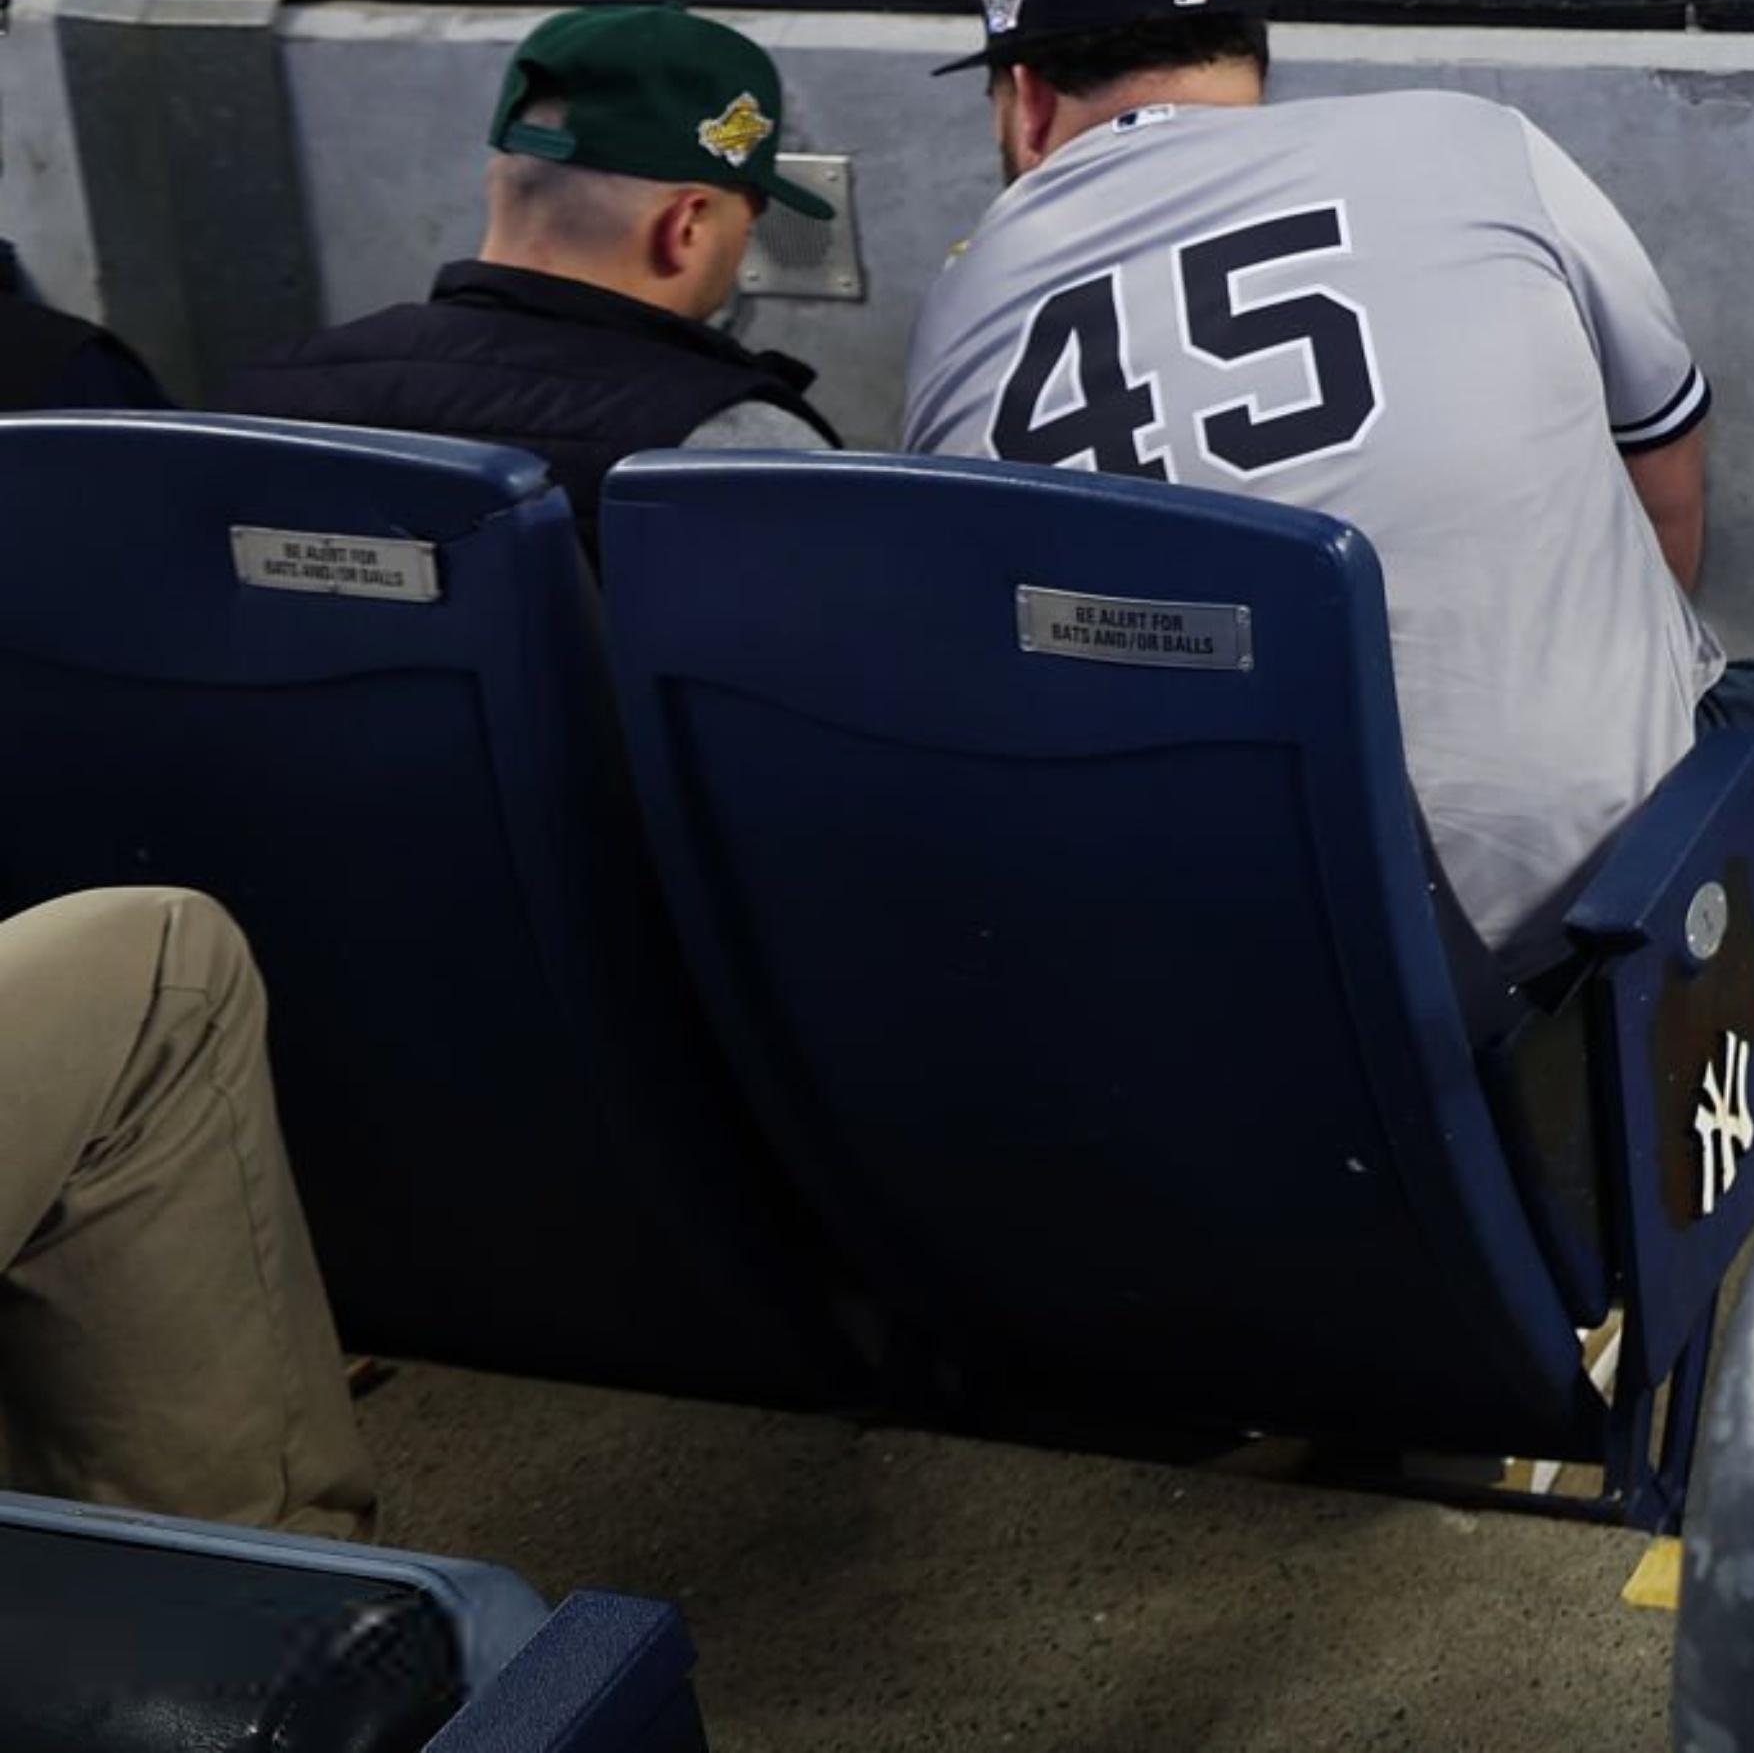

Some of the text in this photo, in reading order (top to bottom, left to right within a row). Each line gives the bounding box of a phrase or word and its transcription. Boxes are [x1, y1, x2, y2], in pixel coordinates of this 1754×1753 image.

[987, 199, 1384, 483] 45
[1076, 606, 1184, 632] BE ALERT FOR
[1052, 623, 1090, 644] BATS
[1163, 634, 1214, 655] BALLS
